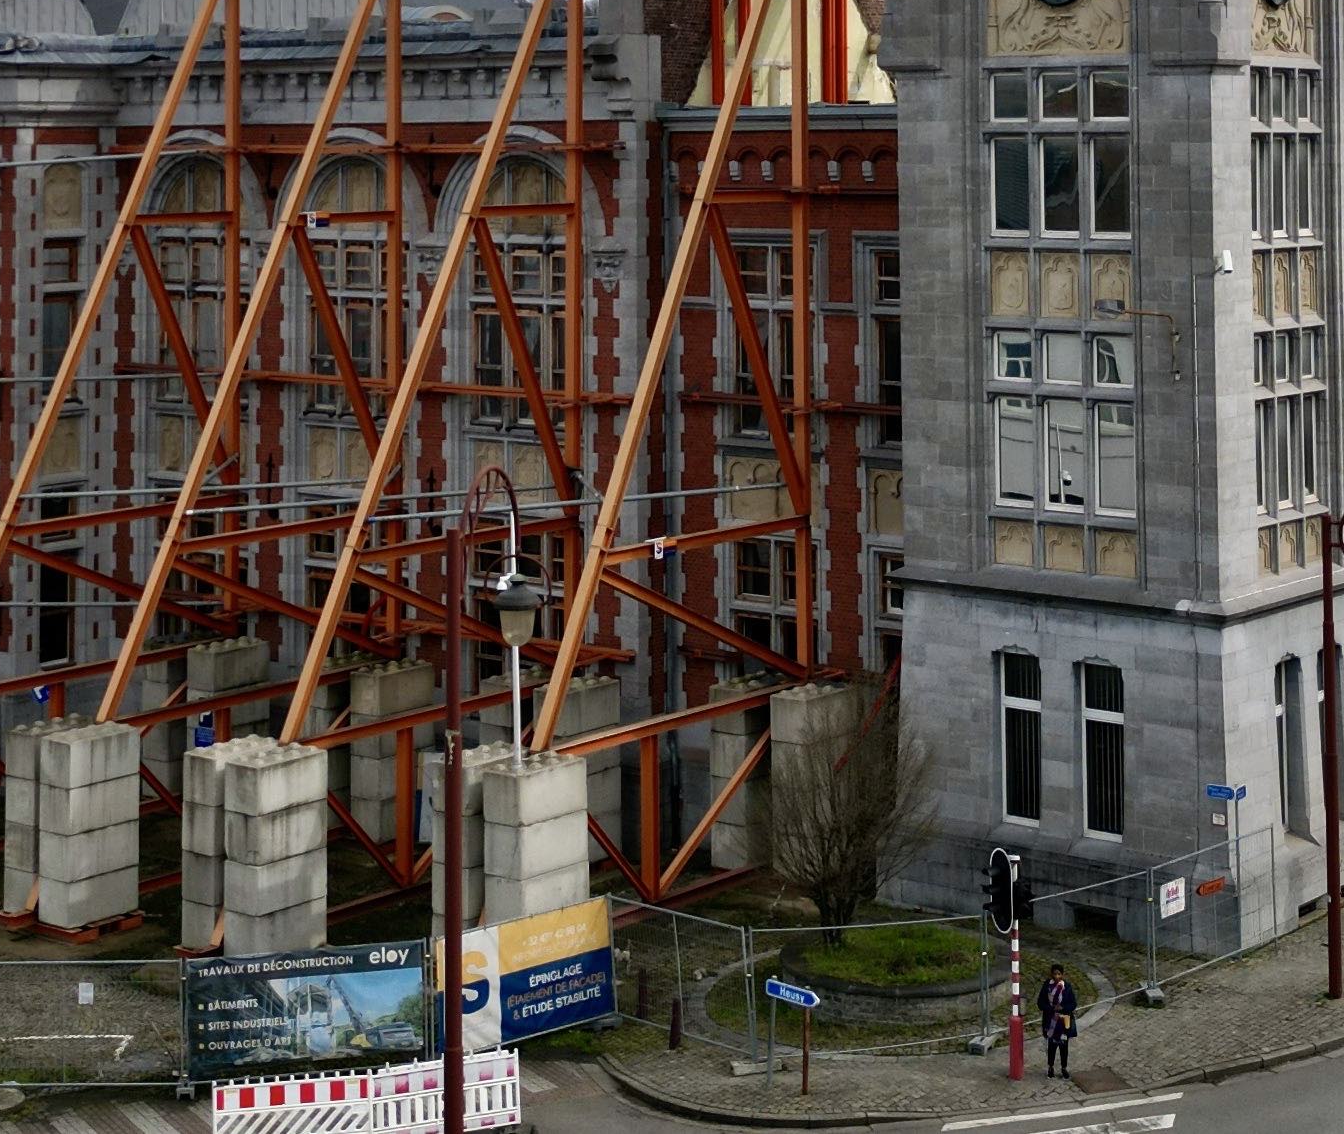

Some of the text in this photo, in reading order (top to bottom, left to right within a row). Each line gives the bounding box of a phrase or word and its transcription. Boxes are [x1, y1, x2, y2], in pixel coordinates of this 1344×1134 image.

[369, 946, 409, 966] eloy
[198, 955, 354, 978] TRAVAUX DE DÉCONSTRUCTION
[528, 962, 583, 988] ÉPINGLAGE
[555, 981, 567, 994] DE
[779, 986, 805, 1004] Heusy
[208, 997, 259, 1012] BÂTIMENTS
[513, 983, 601, 1020] & ÉTUDE STABILITÉ
[208, 1016, 289, 1031] SITES INDUSTRIELS
[208, 1039, 261, 1051] OUVRAGES
